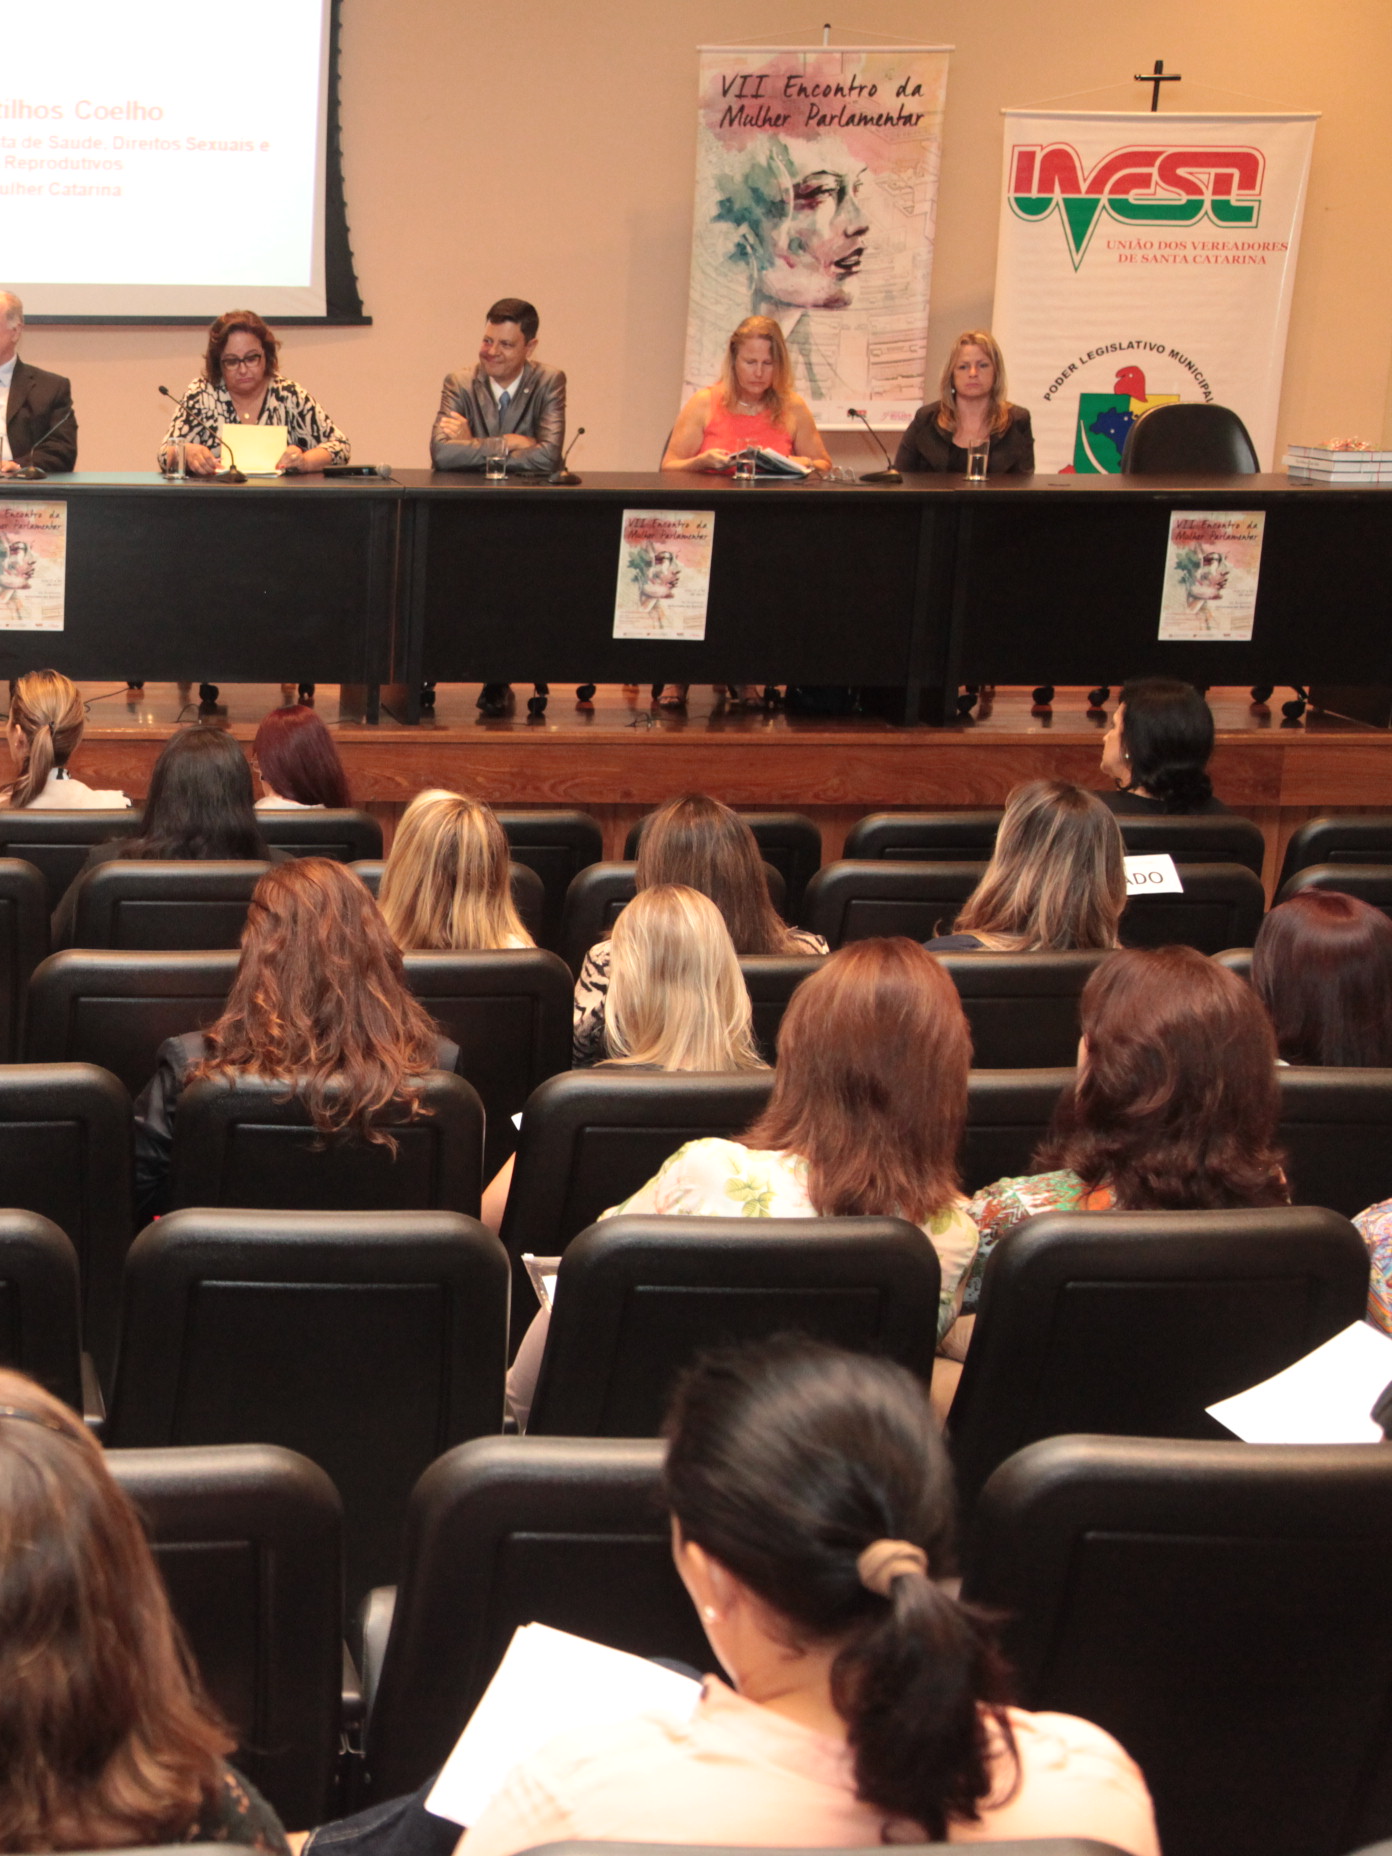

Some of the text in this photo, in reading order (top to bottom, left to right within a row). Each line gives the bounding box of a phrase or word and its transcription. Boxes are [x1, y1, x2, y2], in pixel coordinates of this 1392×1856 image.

[722, 73, 924, 98] VII Encontro da
[74, 99, 165, 121] Coelho
[719, 102, 925, 129] Mulher Parlamentar
[21, 135, 43, 149] de
[112, 135, 182, 151] Direitos
[185, 136, 255, 152] Sexuais
[259, 140, 270, 152] e
[4, 155, 124, 173] Reprodutivos
[48, 182, 123, 198] Catarina
[1106, 238, 1289, 252] UNIÃO DOS VEREADORES
[1118, 253, 1267, 265] DE SANTA CATARINA
[1043, 362, 1079, 402] PODER
[1079, 340, 1167, 366] LEGISLATIVO
[4, 508, 43, 518] Encontro
[651, 518, 690, 528] Encontro
[1201, 519, 1241, 529] Encontro
